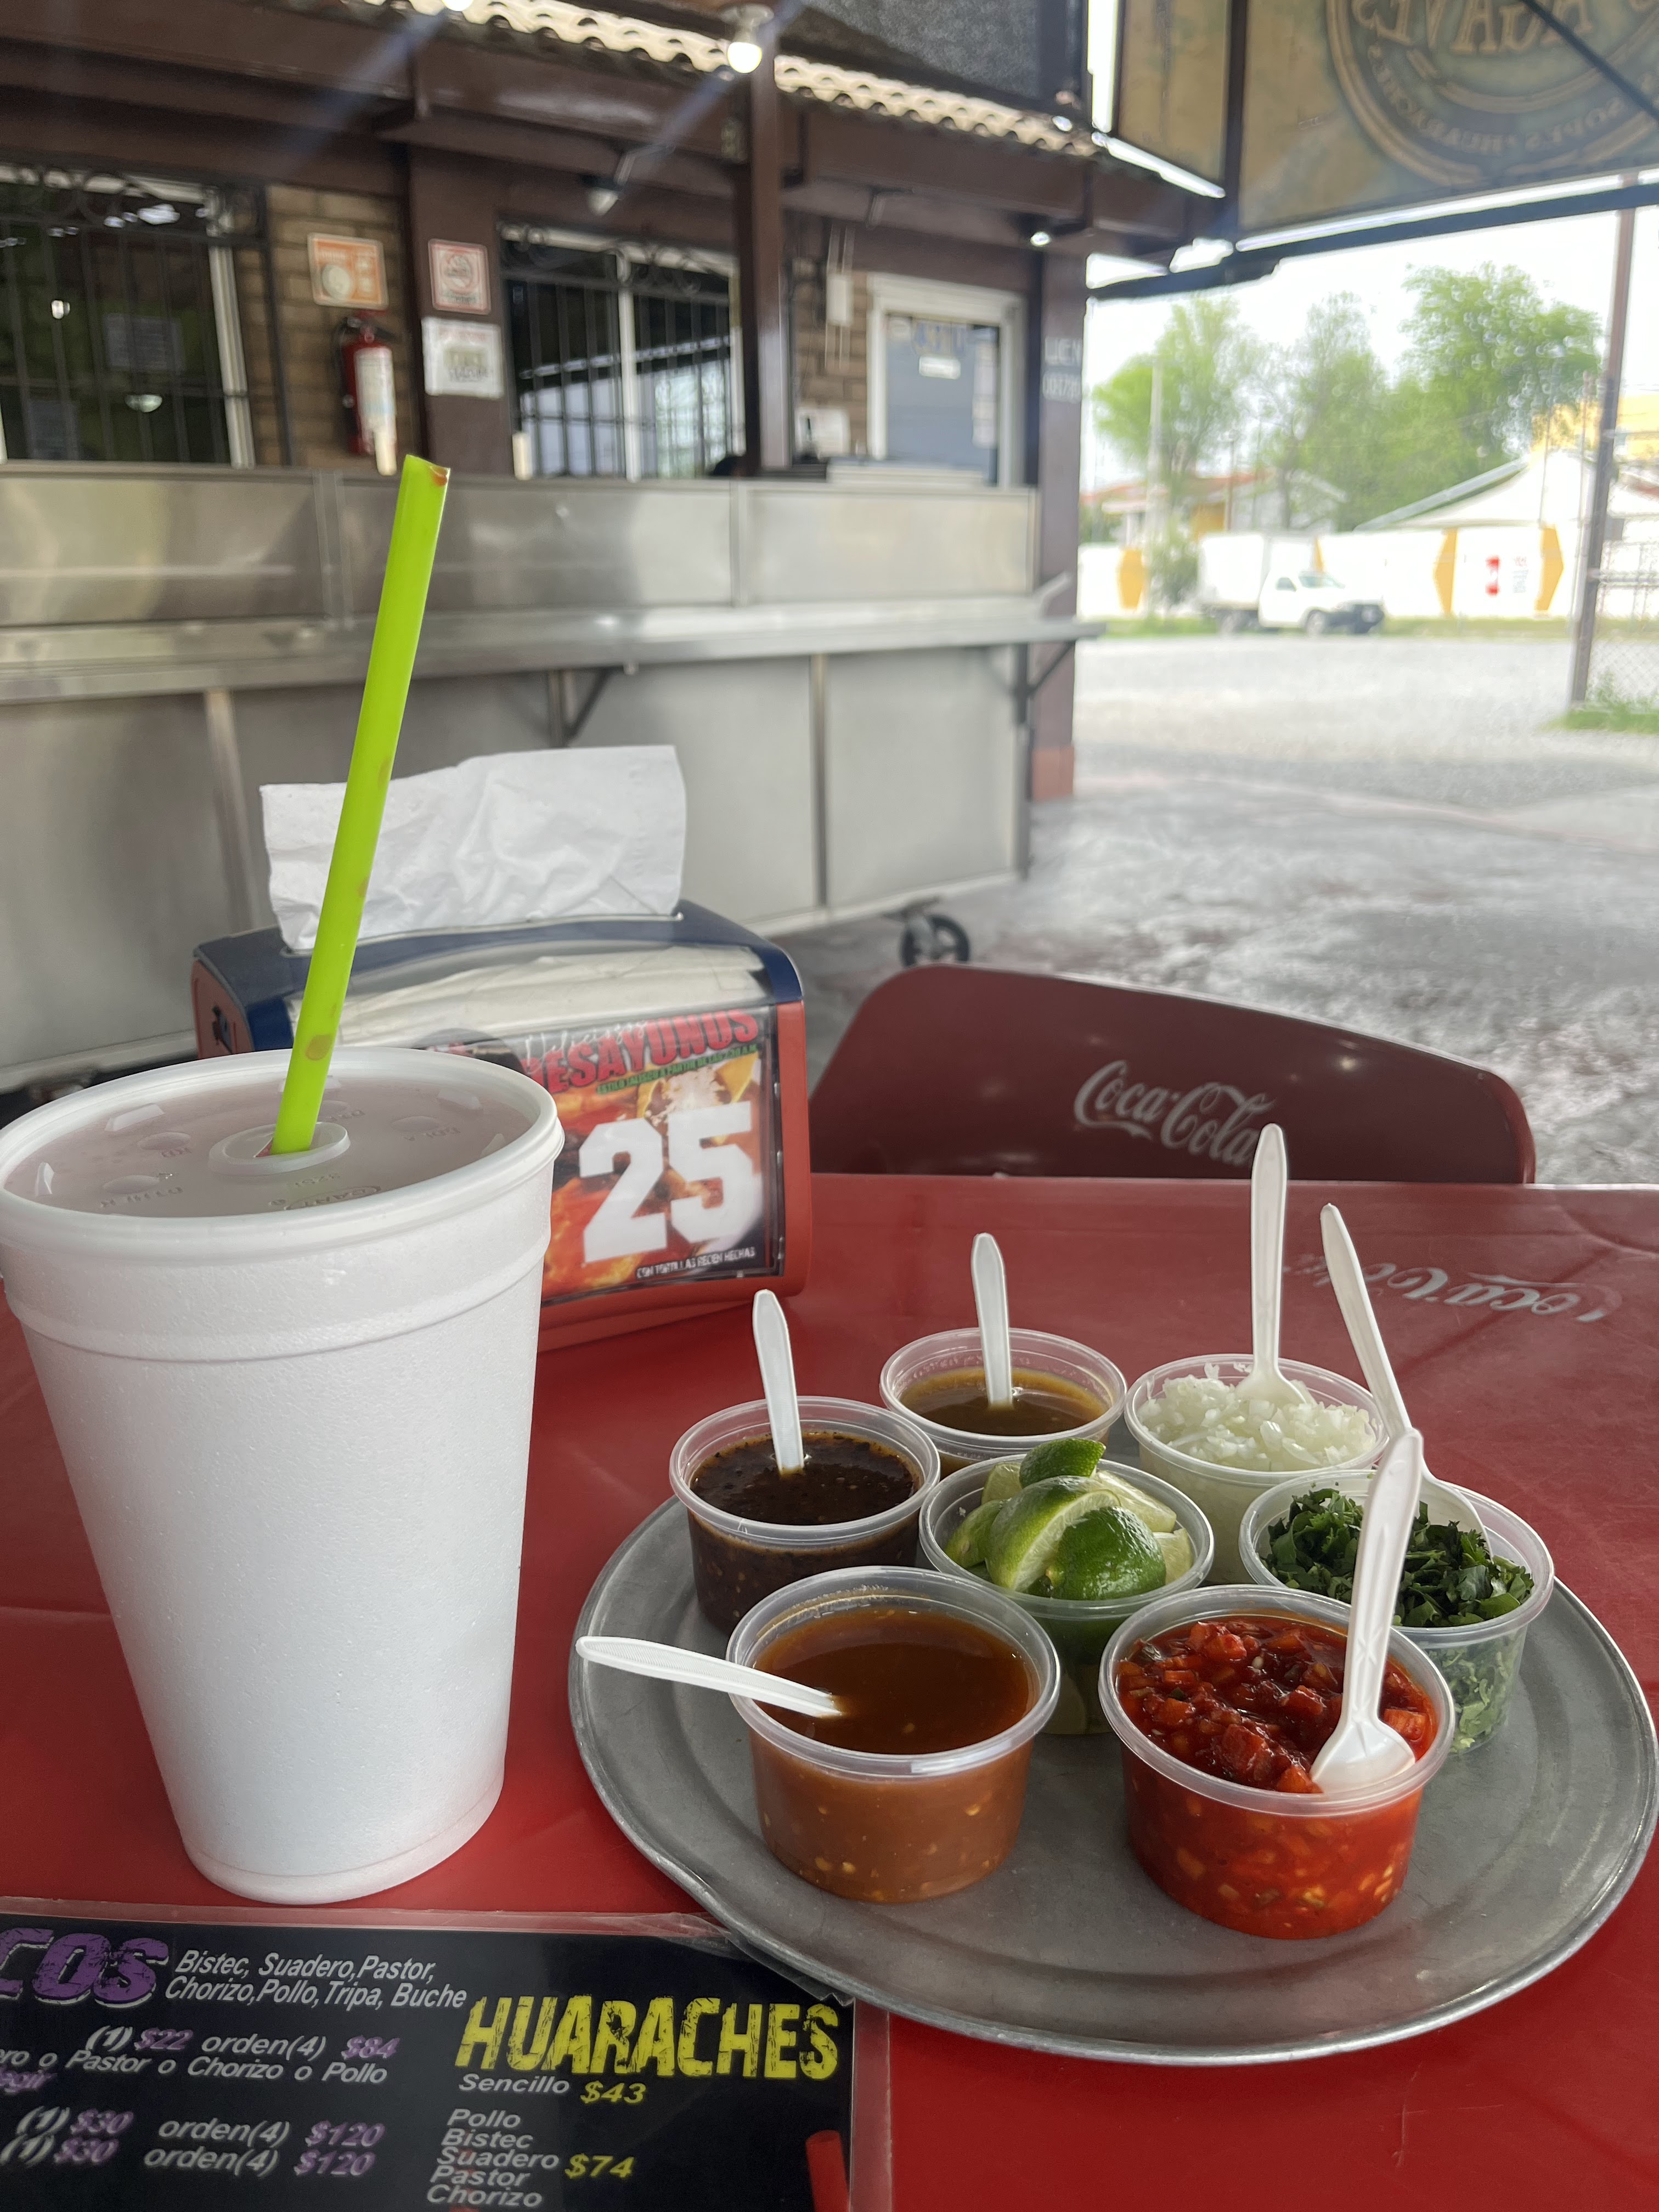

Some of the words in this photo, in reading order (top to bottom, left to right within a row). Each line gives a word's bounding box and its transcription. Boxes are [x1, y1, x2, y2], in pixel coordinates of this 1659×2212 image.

[579, 1101, 760, 1264] 25
[174, 1949, 250, 1978] Bistec,
[390, 1982, 468, 2008] Buche
[454, 1994, 839, 2081] HUARACHES
[39, 2052, 58, 2068] o
[65, 2049, 153, 2073] Pastor
[157, 2058, 177, 2075] o
[187, 2055, 284, 2080] Chorizo
[294, 2066, 313, 2081] o
[321, 2061, 388, 2084] Pollo
[458, 2073, 571, 2094] Sencillo
[580, 2080, 647, 2104] $43
[447, 2108, 521, 2129] Pollo
[305, 2119, 386, 2147] $120
[441, 2128, 534, 2149] Bistec
[294, 2148, 377, 2176] $120
[430, 2164, 531, 2187] Pastor
[436, 2146, 560, 2169] Suadero
[564, 2153, 635, 2179] $74
[426, 2183, 543, 2208] Chorizo
